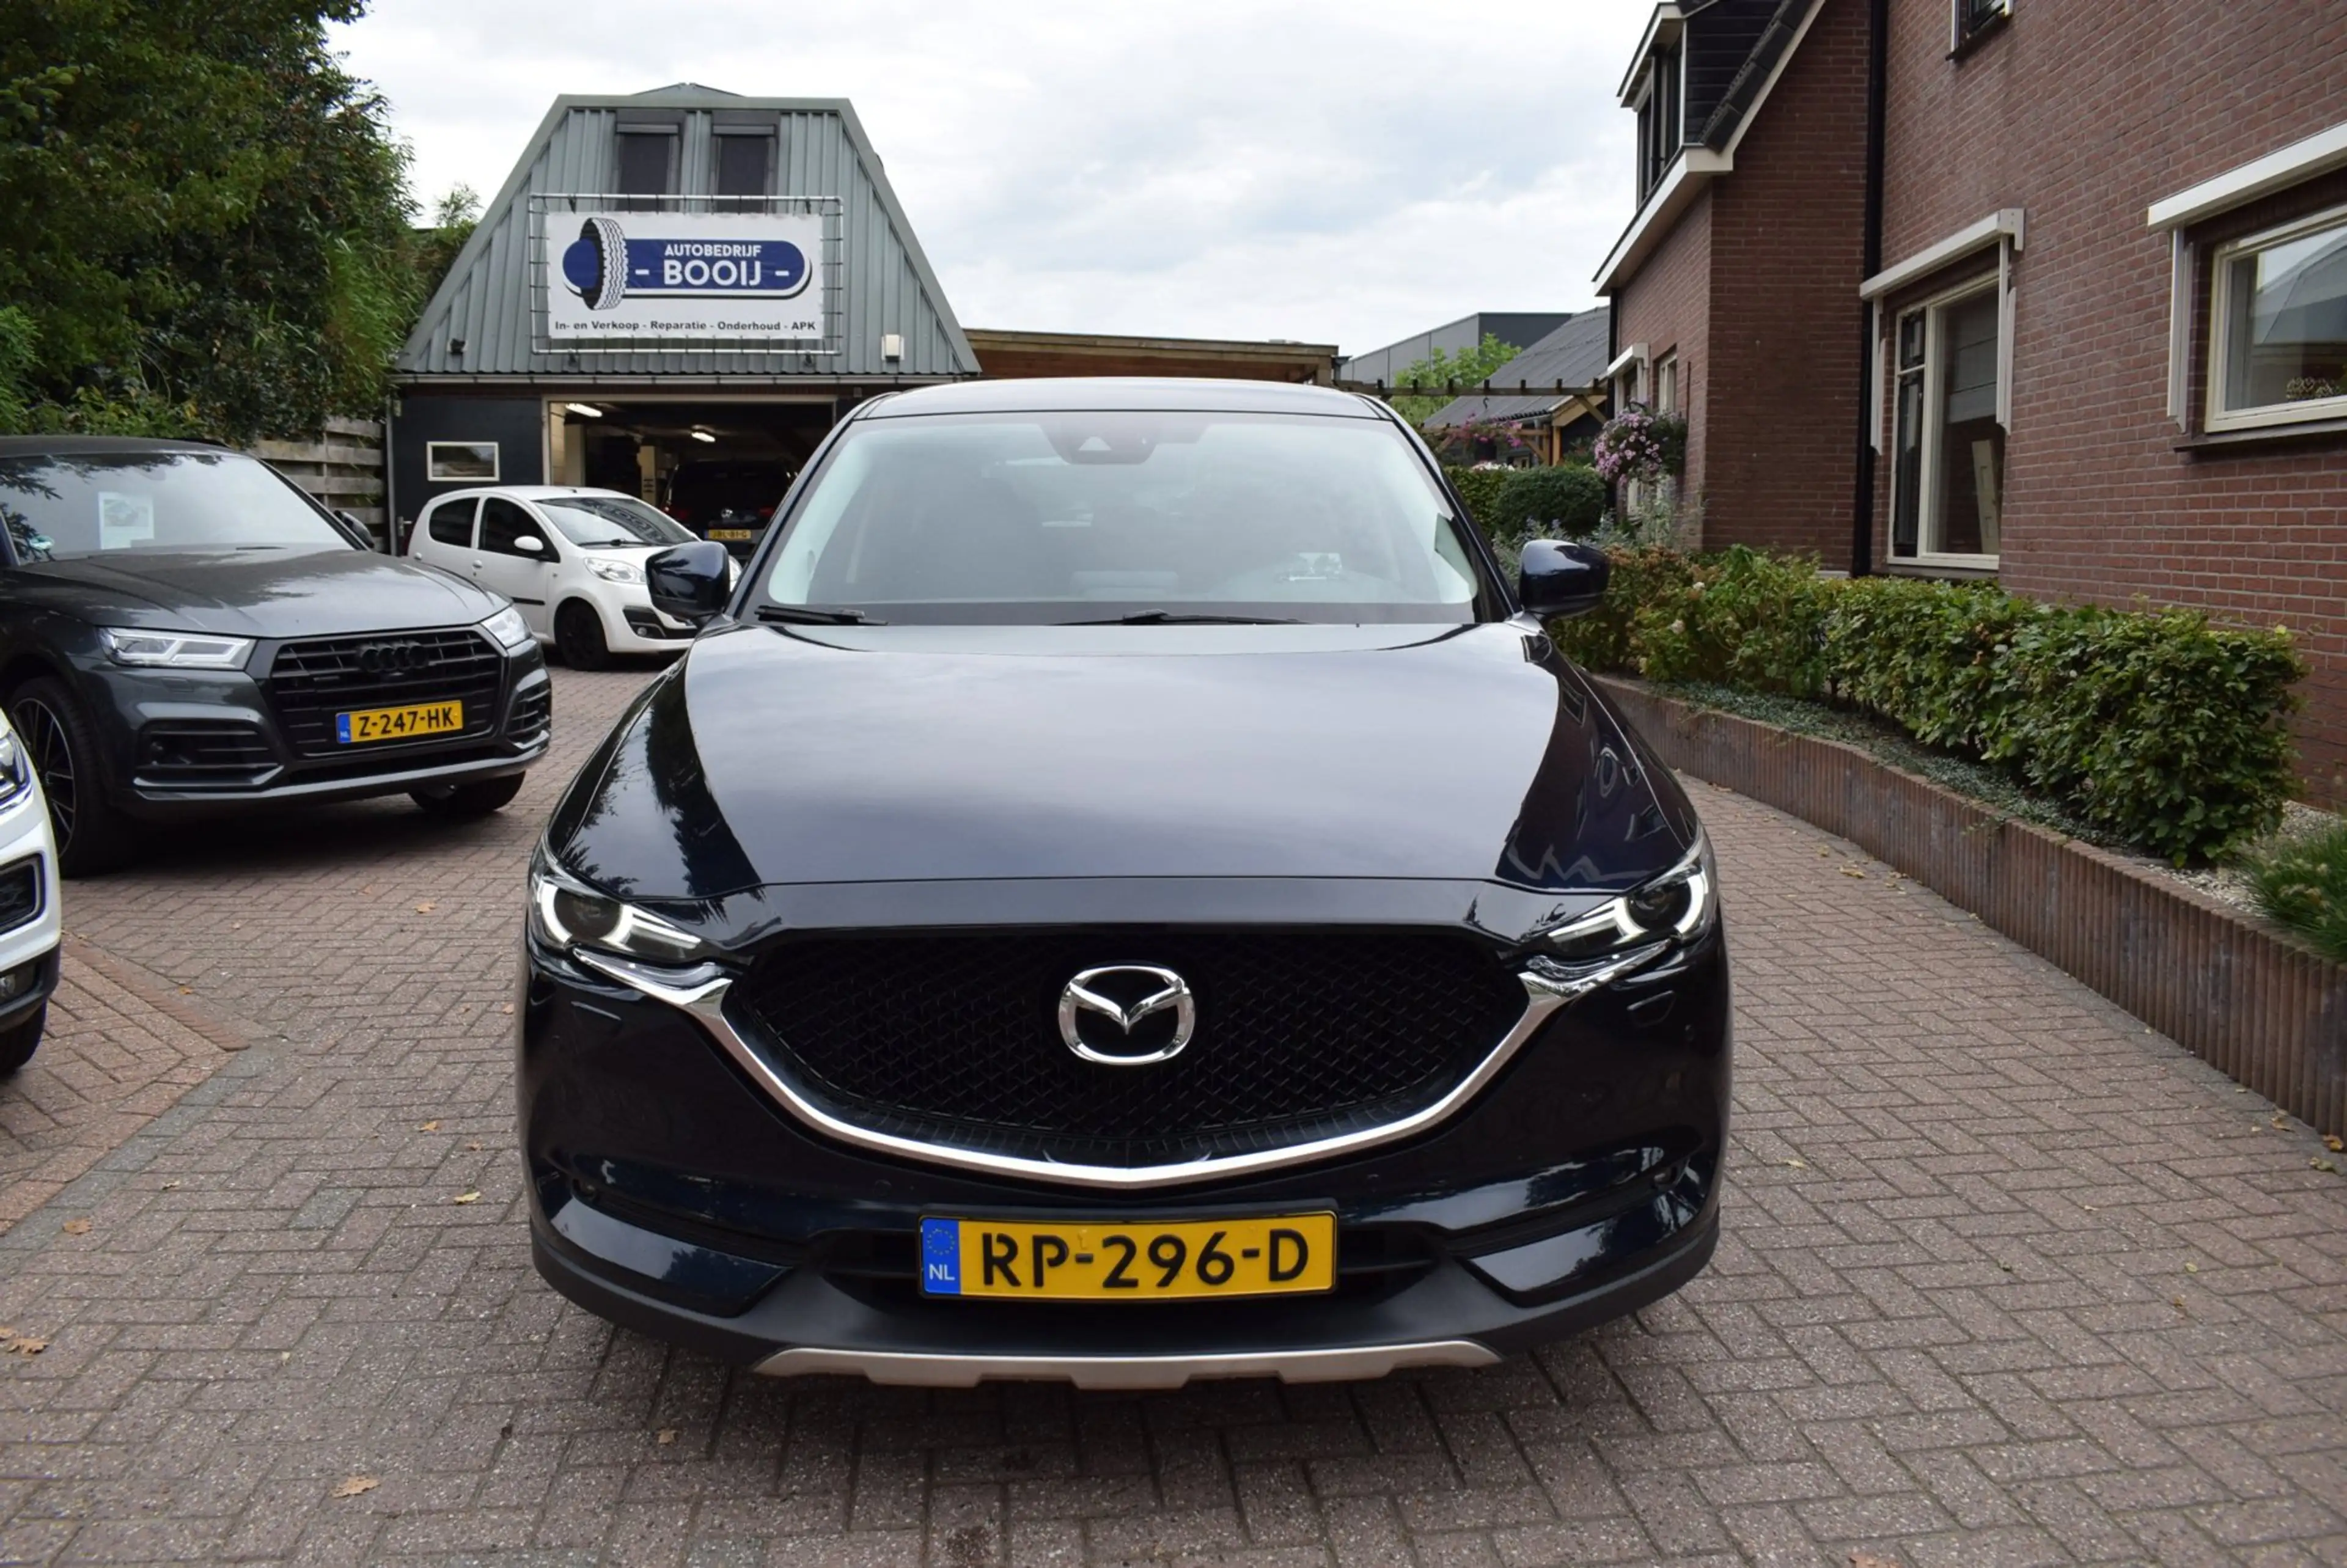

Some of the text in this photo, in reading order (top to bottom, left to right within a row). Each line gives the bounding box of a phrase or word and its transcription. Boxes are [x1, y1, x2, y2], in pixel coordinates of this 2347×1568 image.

[664, 244, 762, 257] AUTOBEDRIJF
[664, 260, 761, 285] BOOIJ
[591, 321, 639, 331] Verkoop
[650, 321, 707, 331] Reparatie
[718, 321, 781, 331] Onderhoud
[792, 321, 816, 331] APK
[358, 706, 455, 737] Z-247-HK
[981, 1228, 1309, 1289] RP-296-D
[928, 1263, 955, 1281] NL
